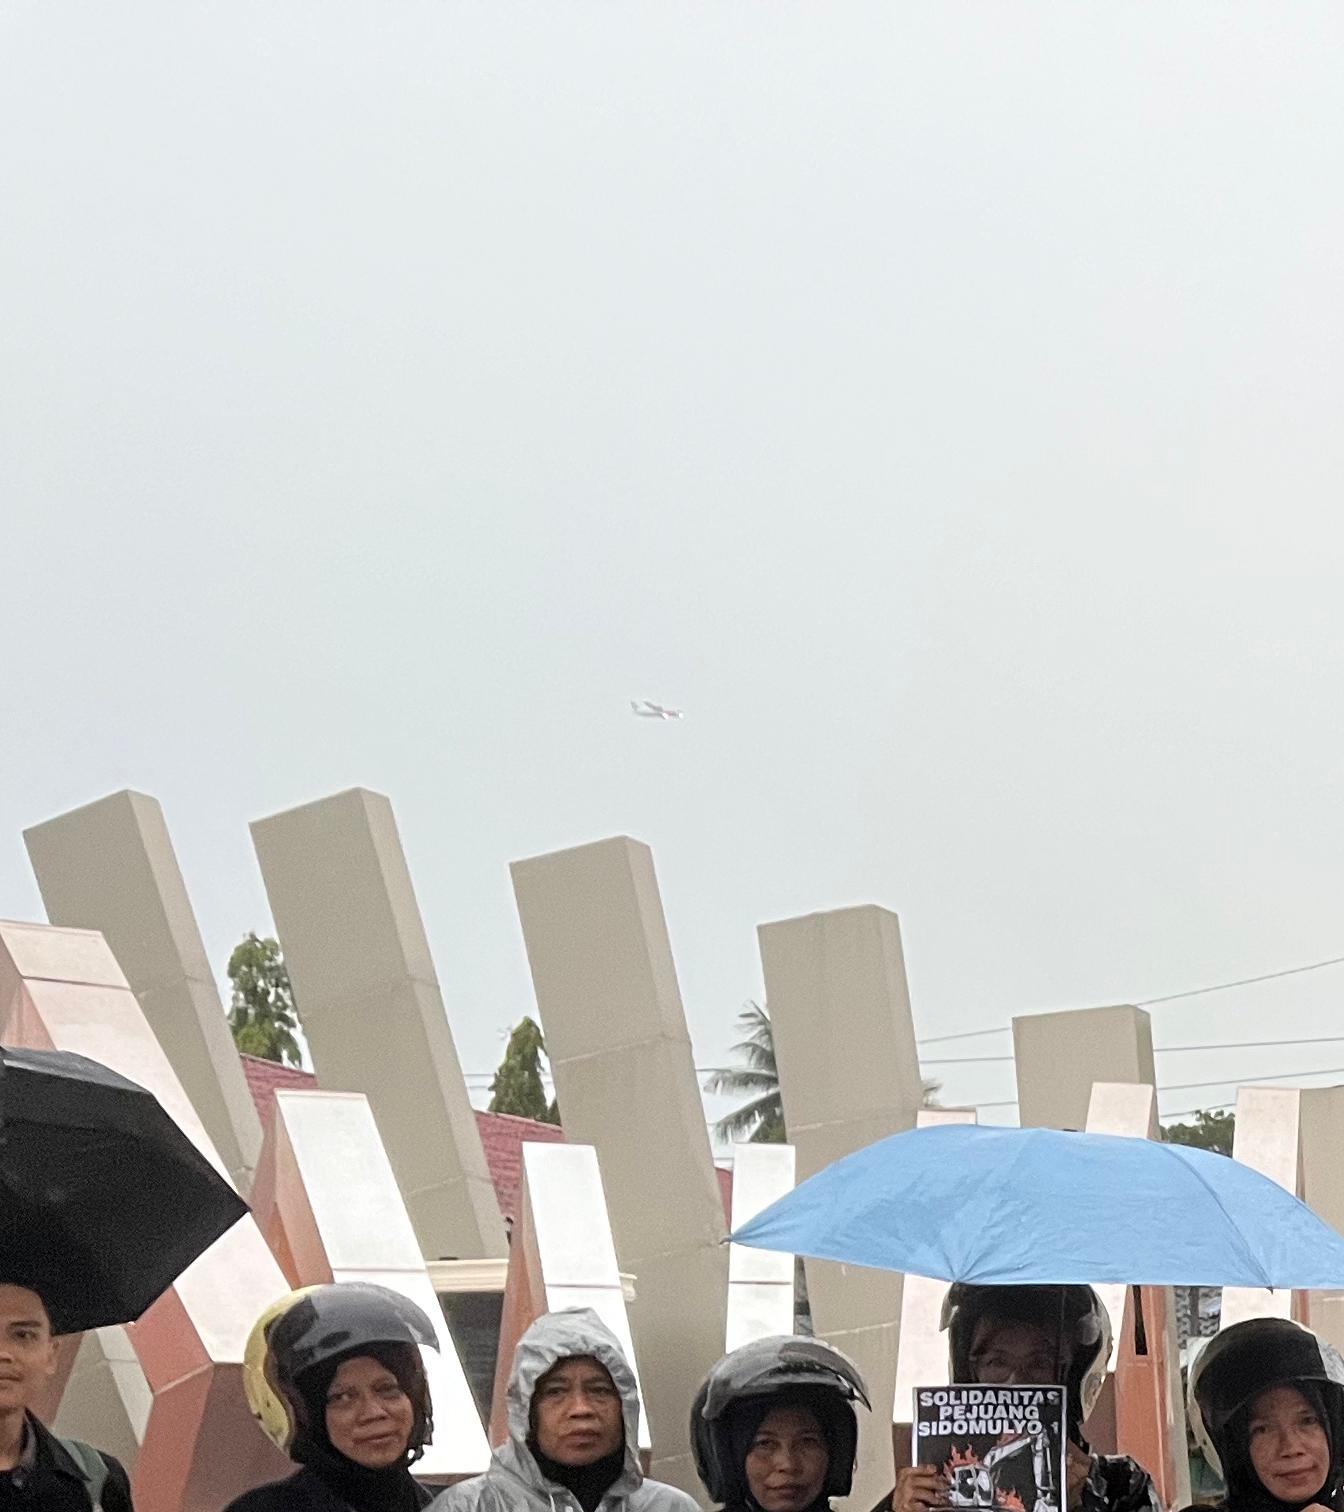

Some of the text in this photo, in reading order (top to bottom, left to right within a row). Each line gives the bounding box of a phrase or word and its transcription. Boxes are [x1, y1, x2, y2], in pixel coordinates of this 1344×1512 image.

[919, 1390, 1060, 1407] SOLIDARITAS
[939, 1404, 1040, 1420] PEJUANG
[918, 1420, 1043, 1437] SIDOMULYO
